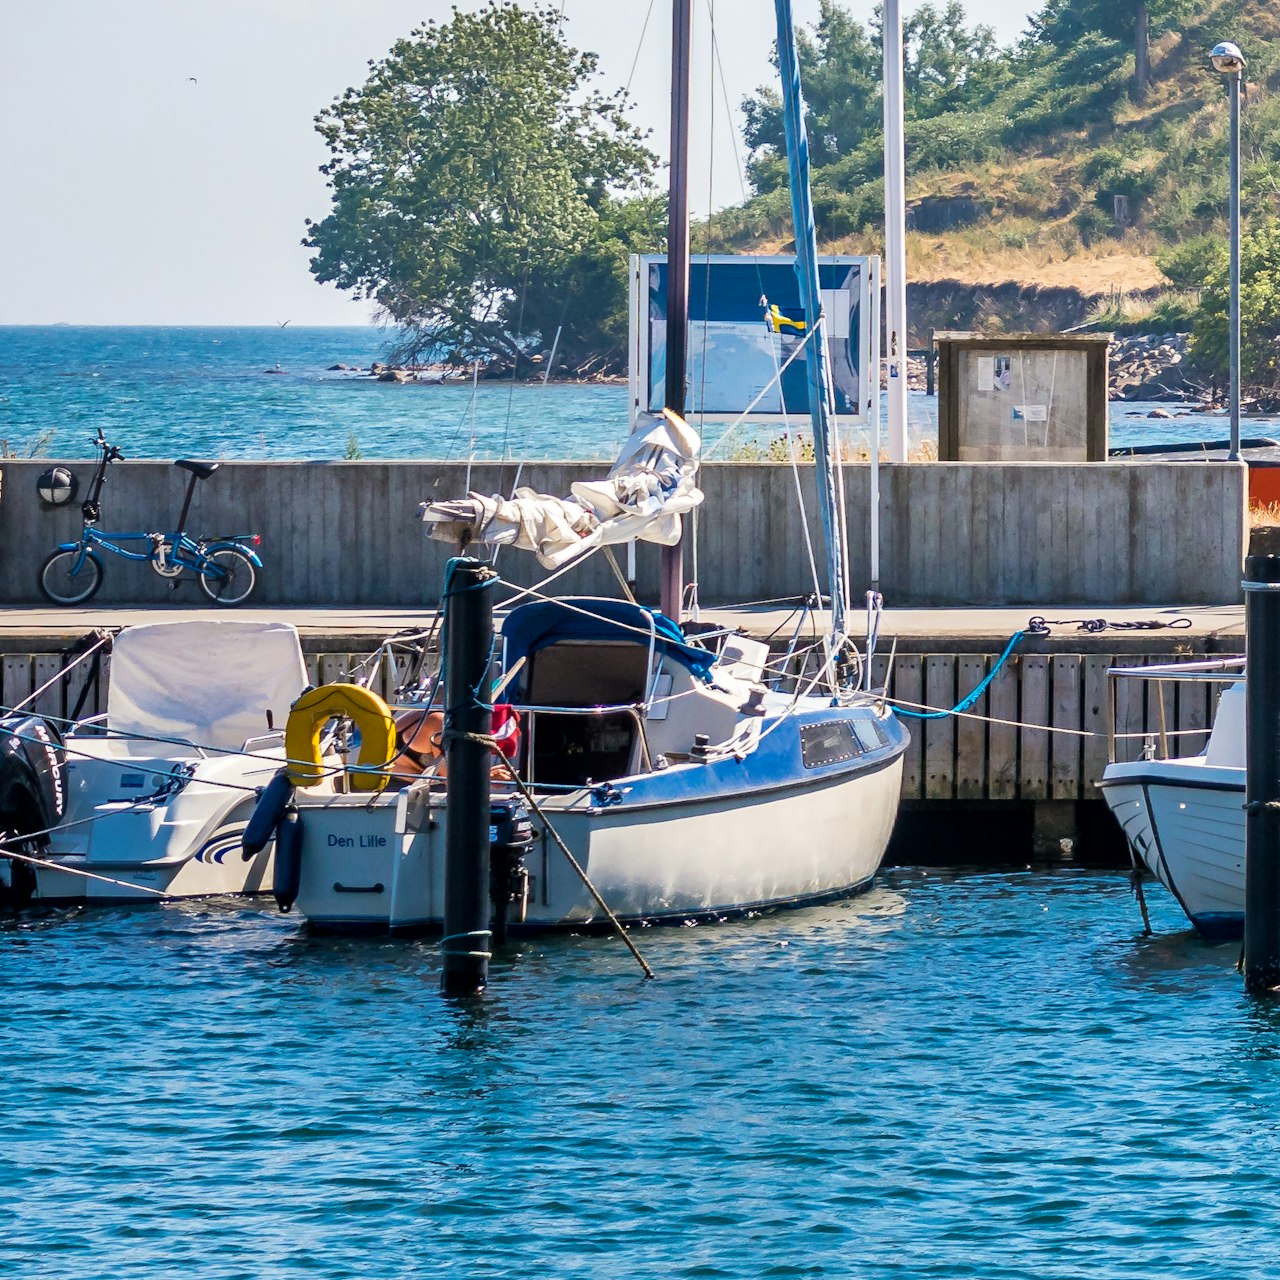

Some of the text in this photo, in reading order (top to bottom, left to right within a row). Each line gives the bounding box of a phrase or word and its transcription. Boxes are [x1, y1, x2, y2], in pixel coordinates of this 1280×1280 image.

[34, 725, 63, 816] MERCURY
[327, 833, 387, 848] Den Lille
